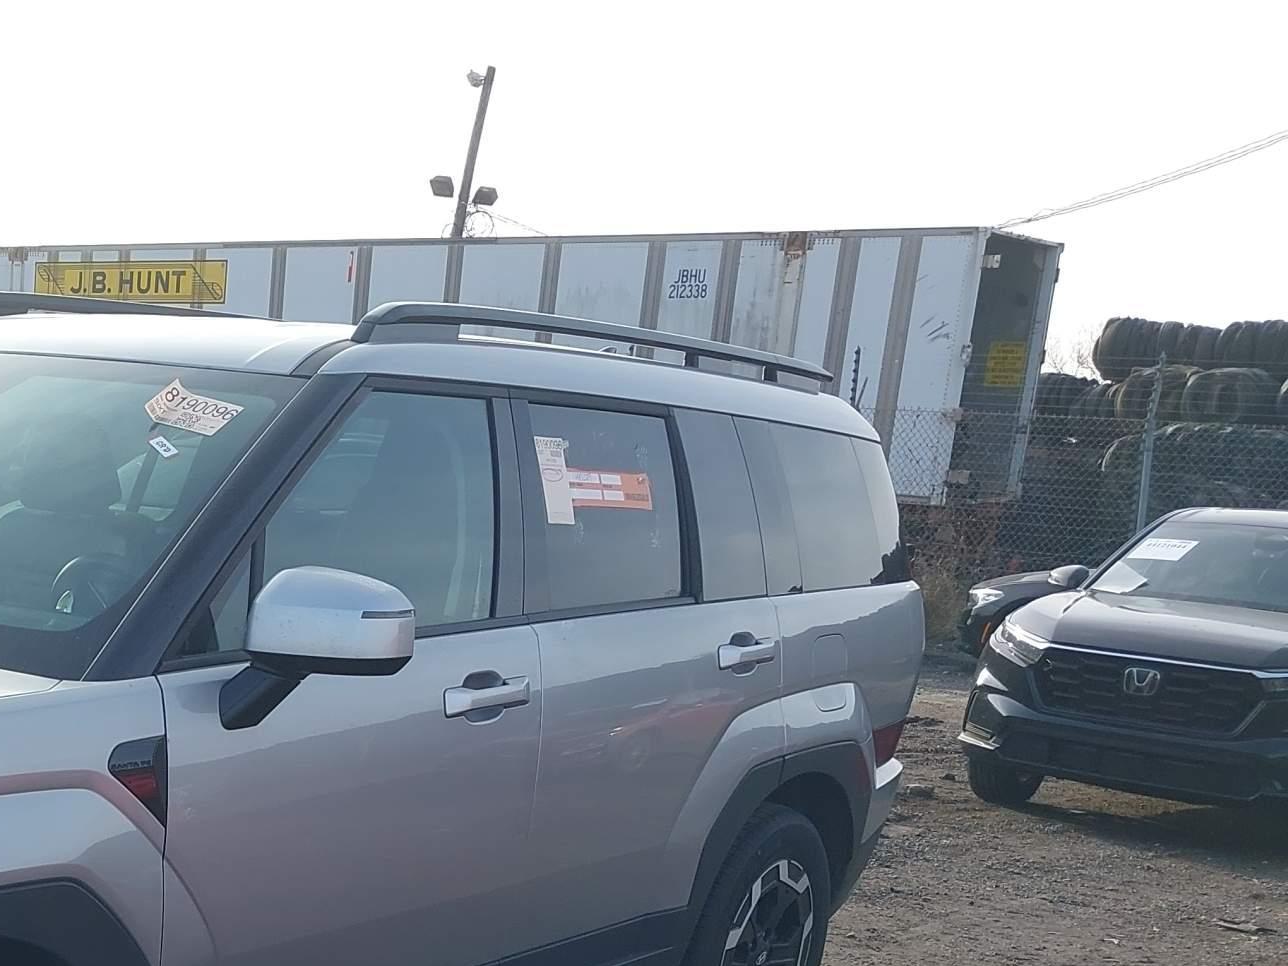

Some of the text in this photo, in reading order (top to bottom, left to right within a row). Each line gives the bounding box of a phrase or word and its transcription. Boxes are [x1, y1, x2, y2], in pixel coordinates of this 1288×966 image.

[118, 270, 187, 294] HUNT
[674, 269, 706, 284] JBHU
[668, 284, 708, 299] 212338
[165, 387, 238, 420] 8190096
